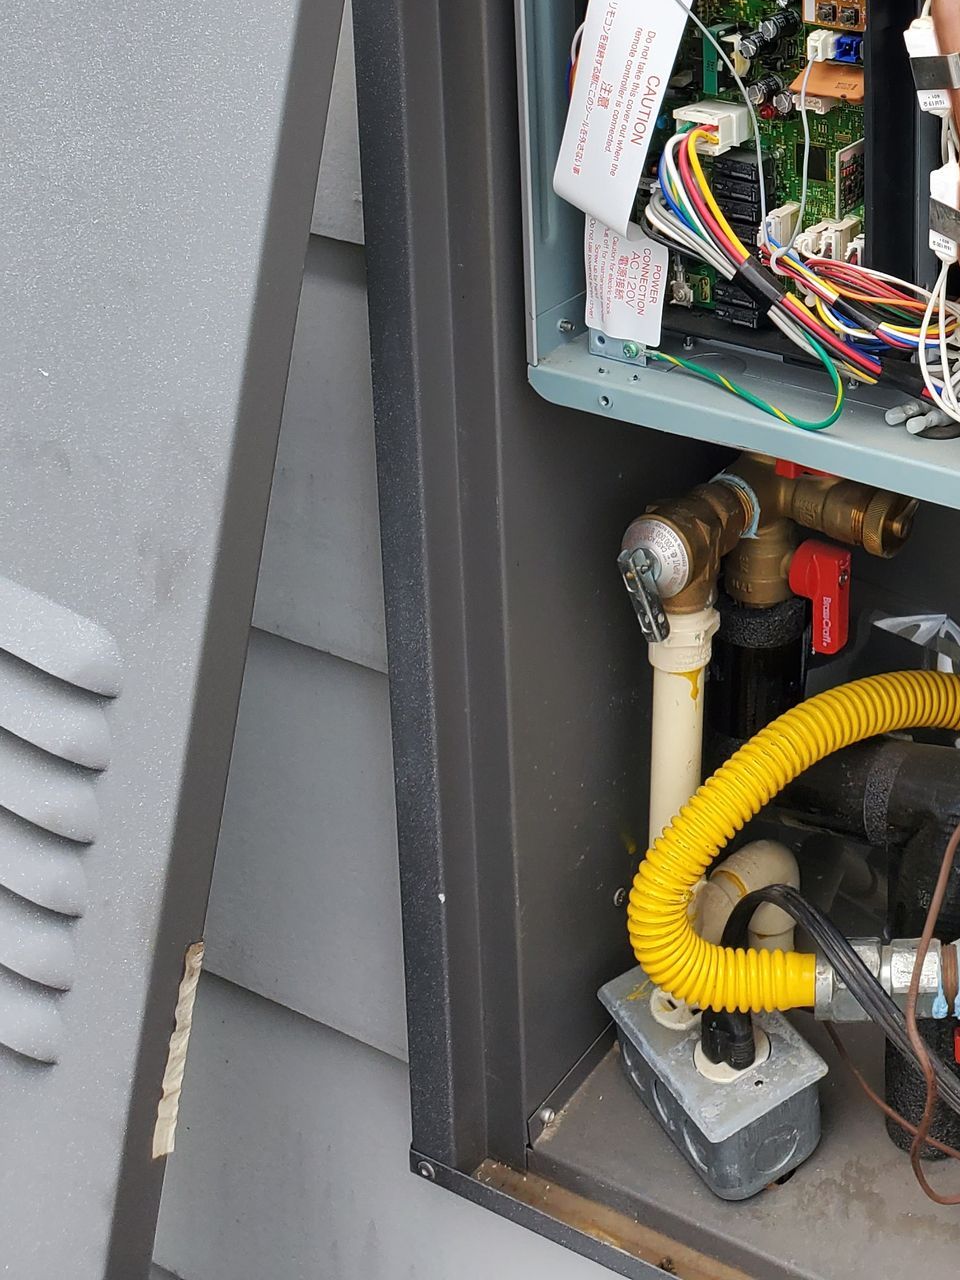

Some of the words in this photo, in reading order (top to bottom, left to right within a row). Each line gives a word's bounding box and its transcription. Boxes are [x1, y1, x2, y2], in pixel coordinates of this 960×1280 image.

[628, 26, 643, 58] remote
[644, 30, 656, 44] Do
[640, 45, 650, 59] not
[616, 58, 634, 98] controller
[633, 61, 645, 80] take
[595, 80, 614, 109] 注意
[628, 81, 639, 98] this
[614, 100, 622, 108] is
[621, 98, 634, 123] cover
[629, 74, 661, 145] CAUTION
[602, 109, 621, 153] connected.
[618, 124, 628, 138] out
[611, 138, 624, 162] when
[608, 163, 618, 176] the
[590, 218, 597, 229] Do
[610, 236, 618, 261] Caution
[629, 250, 641, 270] AC
[624, 275, 638, 308] 120V
[635, 247, 651, 315] CONNECTION
[648, 264, 661, 303] POWER
[822, 596, 832, 644] BrassCraft
